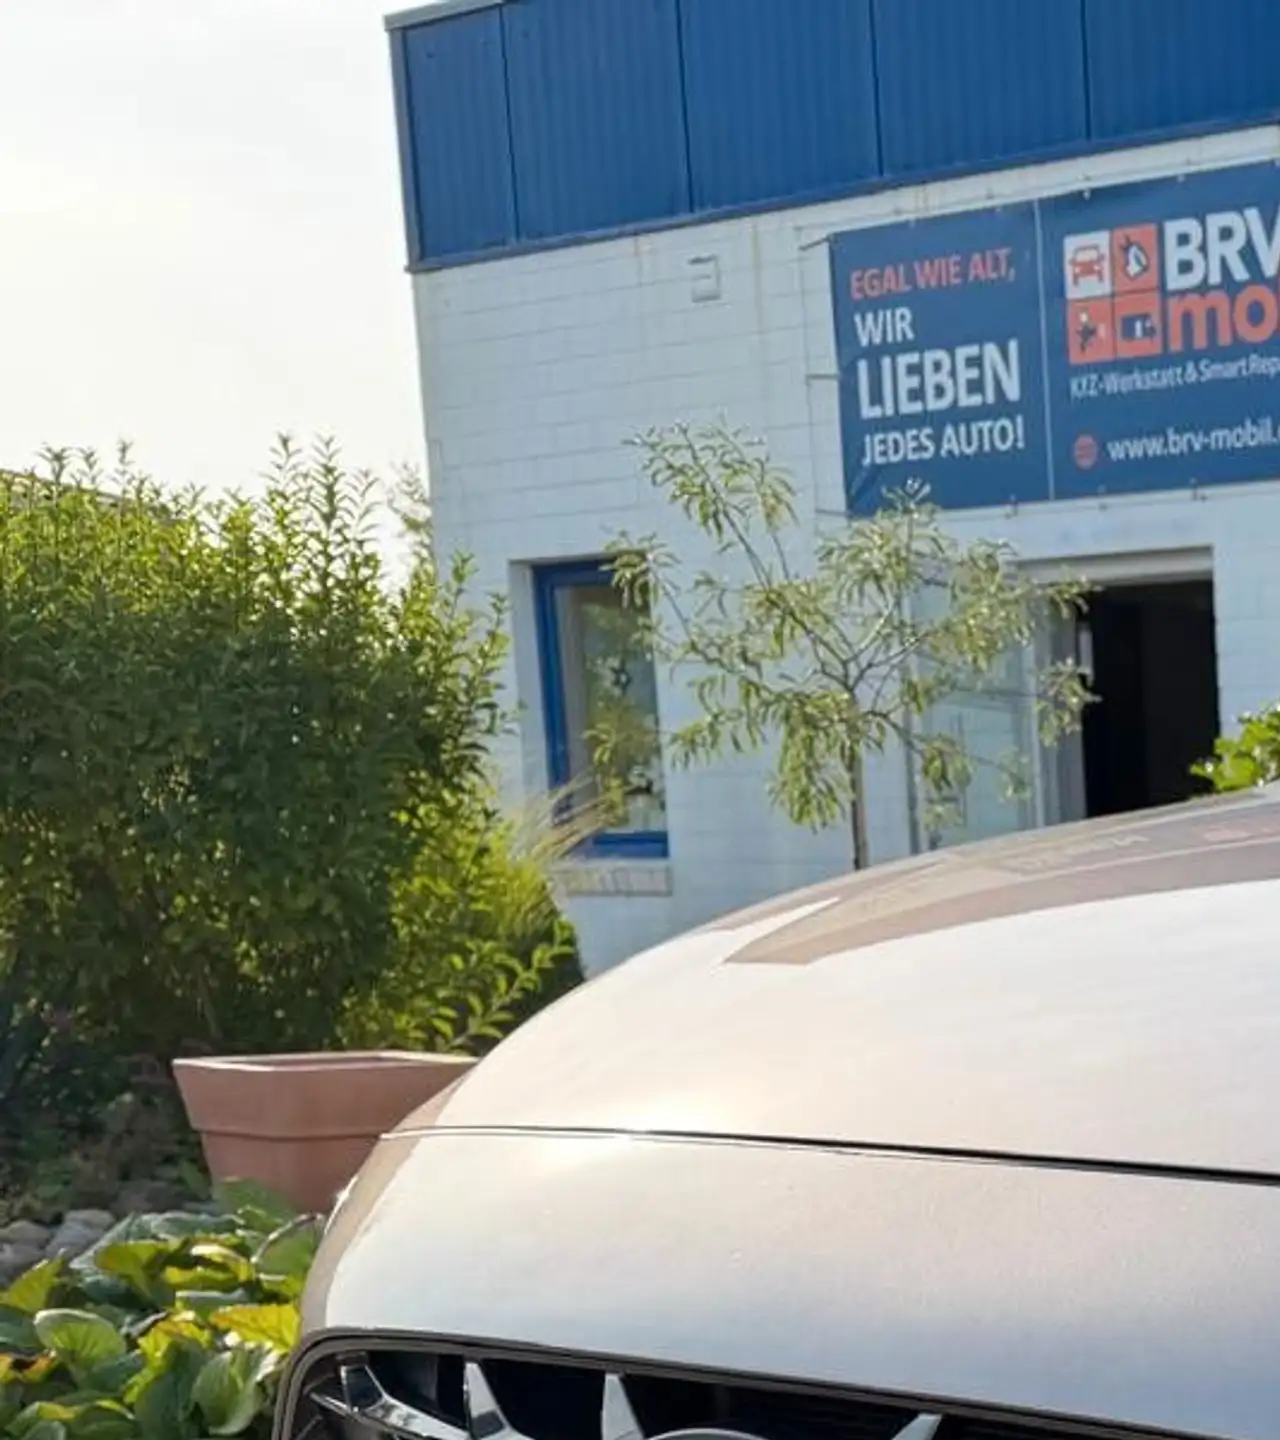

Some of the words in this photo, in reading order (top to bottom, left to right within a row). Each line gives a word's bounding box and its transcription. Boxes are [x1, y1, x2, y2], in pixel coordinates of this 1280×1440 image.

[850, 264, 912, 301] EGAL
[913, 254, 963, 289] WIE
[967, 248, 1016, 283] ALT,
[854, 306, 915, 347] WIR
[857, 338, 1022, 420] LIEBEN
[1069, 365, 1183, 401] KFZ-Werkstatt
[1184, 361, 1198, 383] &
[861, 426, 936, 467] JEDES
[940, 414, 1026, 458] AUTO!
